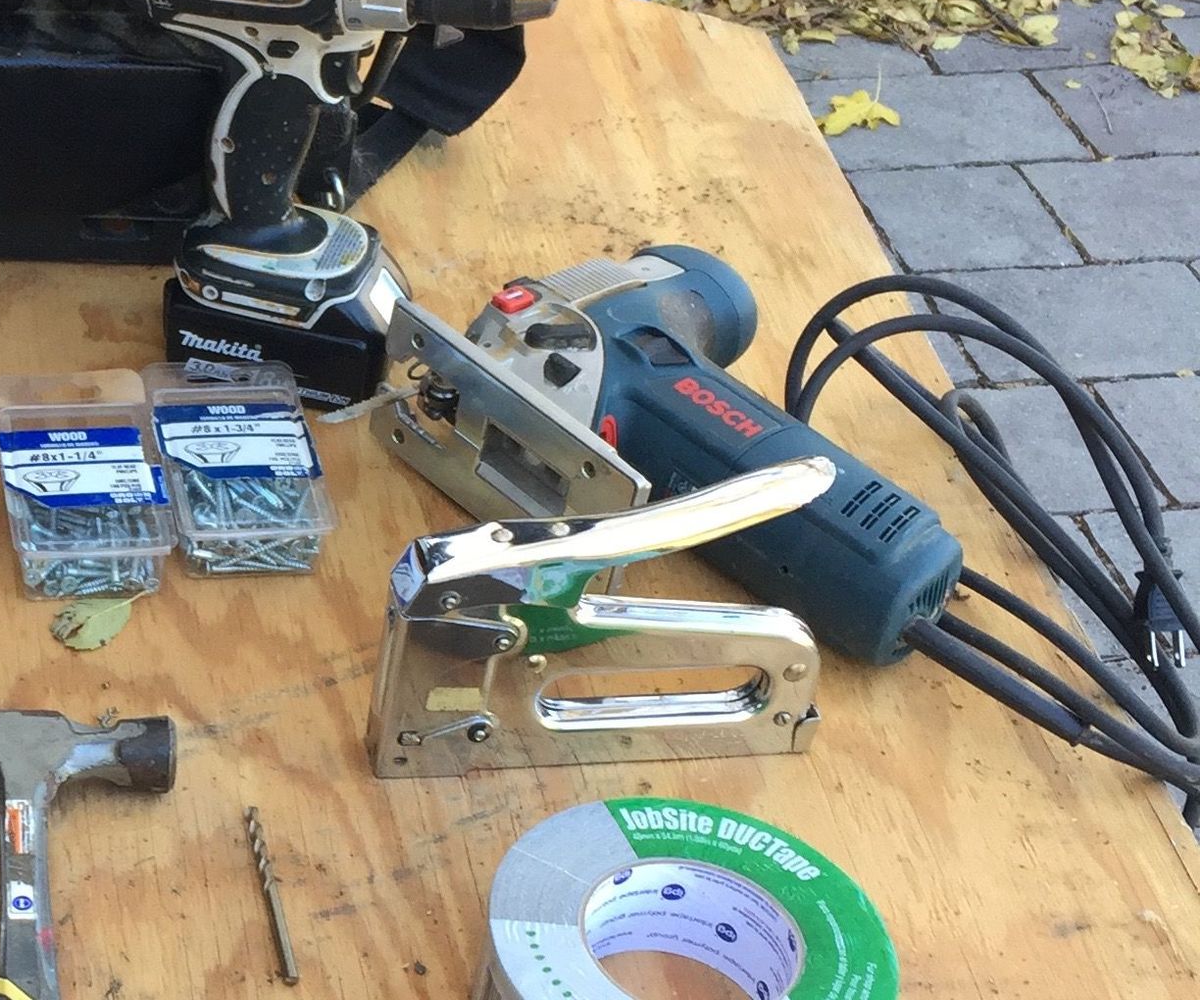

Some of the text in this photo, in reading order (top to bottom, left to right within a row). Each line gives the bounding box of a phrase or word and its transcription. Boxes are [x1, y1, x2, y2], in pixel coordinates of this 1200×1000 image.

[207, 405, 247, 415] WOOD
[672, 376, 765, 438] BOSCH
[48, 431, 88, 442] WOOD
[619, 806, 822, 881] JobSite DUCTape
